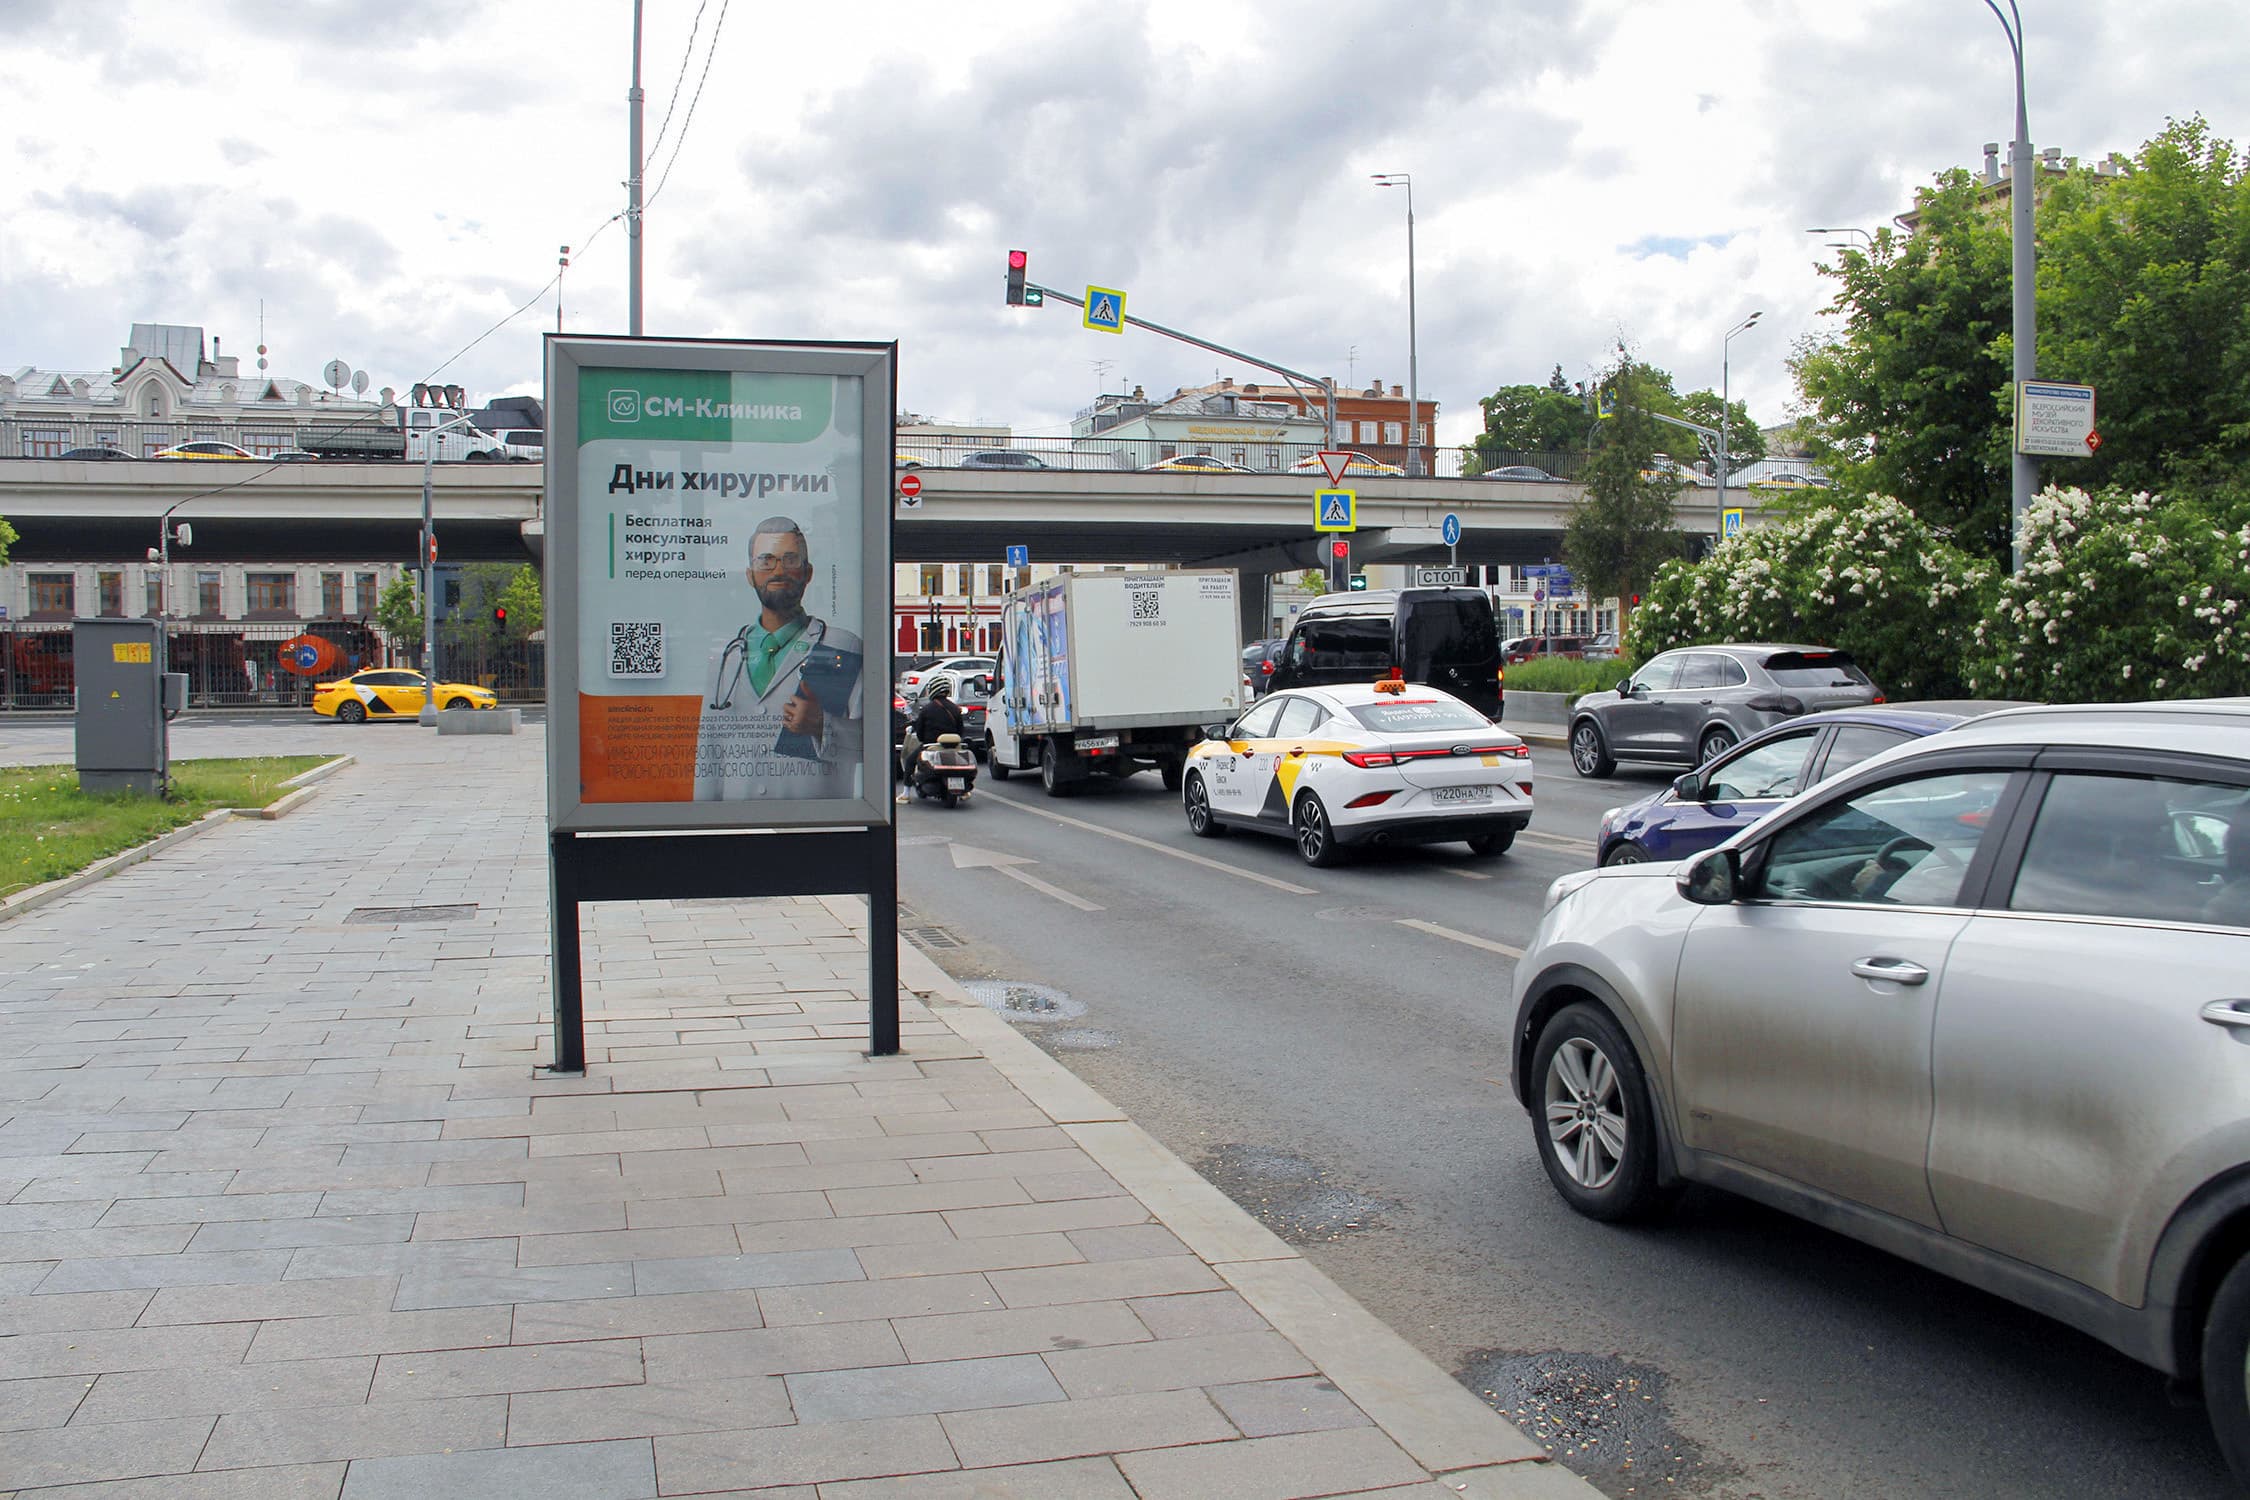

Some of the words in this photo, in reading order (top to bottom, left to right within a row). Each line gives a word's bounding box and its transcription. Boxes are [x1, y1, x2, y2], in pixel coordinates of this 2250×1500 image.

[644, 396, 802, 421] СМ-Клиника
[608, 463, 675, 495] Дни
[681, 471, 829, 499] хирургии
[625, 514, 713, 528] Бесплатная
[625, 534, 729, 547] консультация
[625, 551, 687, 565] хирурга
[625, 570, 661, 581] перед
[663, 569, 727, 581] операцией
[1423, 571, 1461, 583] СТОП
[1436, 788, 1474, 800] Н220НА
